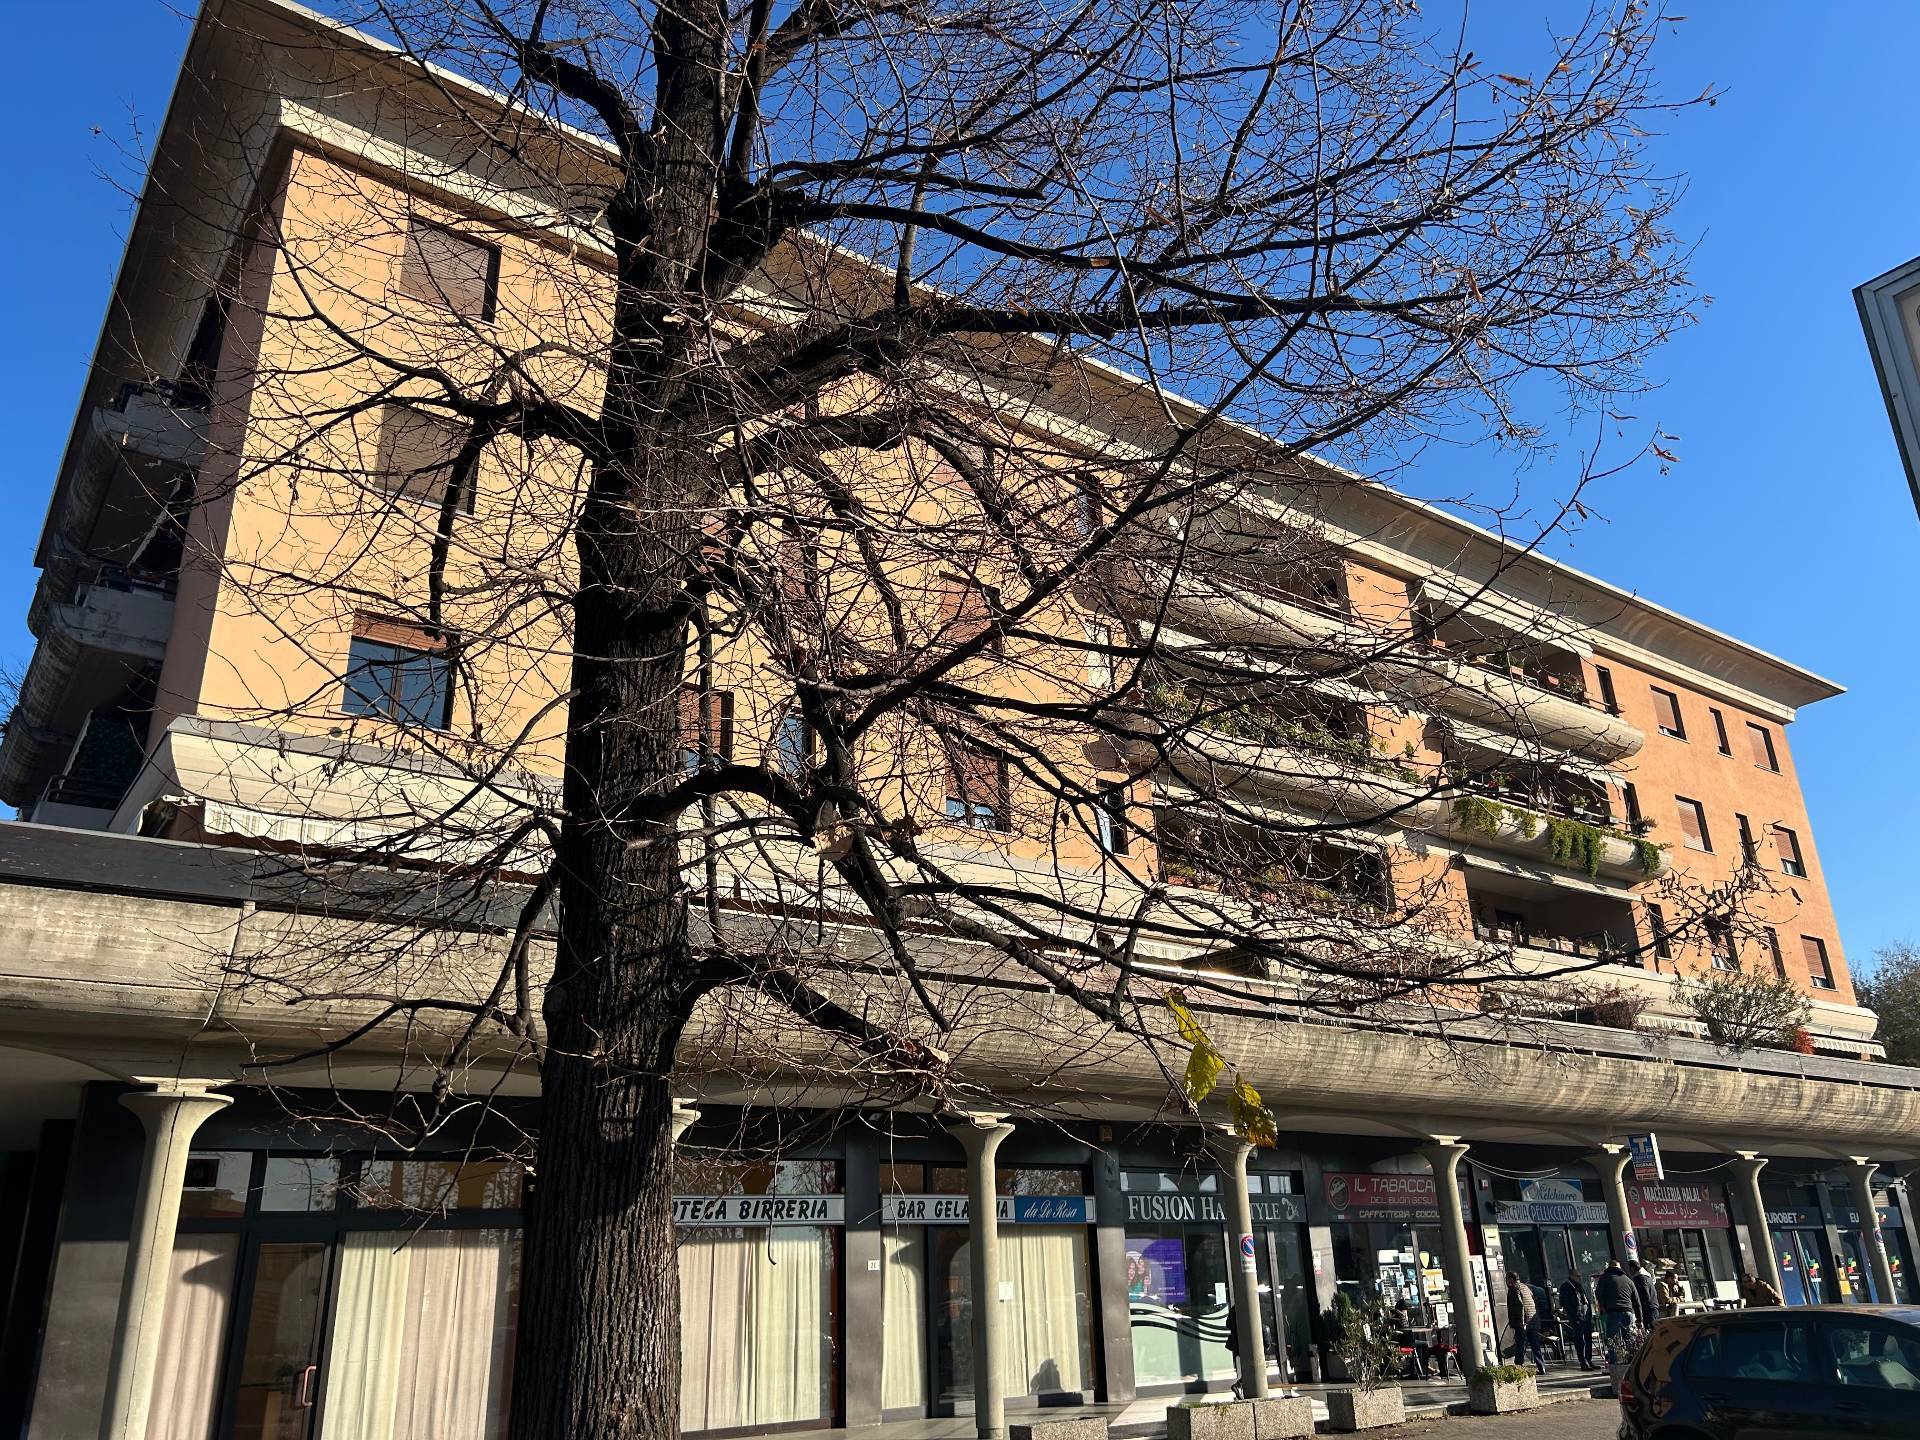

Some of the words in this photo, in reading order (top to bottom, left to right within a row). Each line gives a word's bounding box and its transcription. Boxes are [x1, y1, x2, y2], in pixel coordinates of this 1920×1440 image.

[1354, 1178, 1366, 1192] IL
[1371, 1178, 1436, 1193] TABACCAI
[1643, 1186, 1681, 1202] MACELLERIA
[1681, 1187, 1702, 1202] HALAL
[739, 1199, 828, 1220] BIRRERIA
[897, 1200, 925, 1219] BAR
[934, 1200, 1009, 1219] GELAIA
[1023, 1202, 1038, 1219] da
[1053, 1199, 1078, 1218] Rosa
[1127, 1195, 1195, 1221] FUSION
[1199, 1196, 1226, 1220] HA
[1249, 1202, 1281, 1220] TYLE
[1415, 1210, 1440, 1218] EDICOL
[1530, 1204, 1576, 1221] PELLICCERIA
